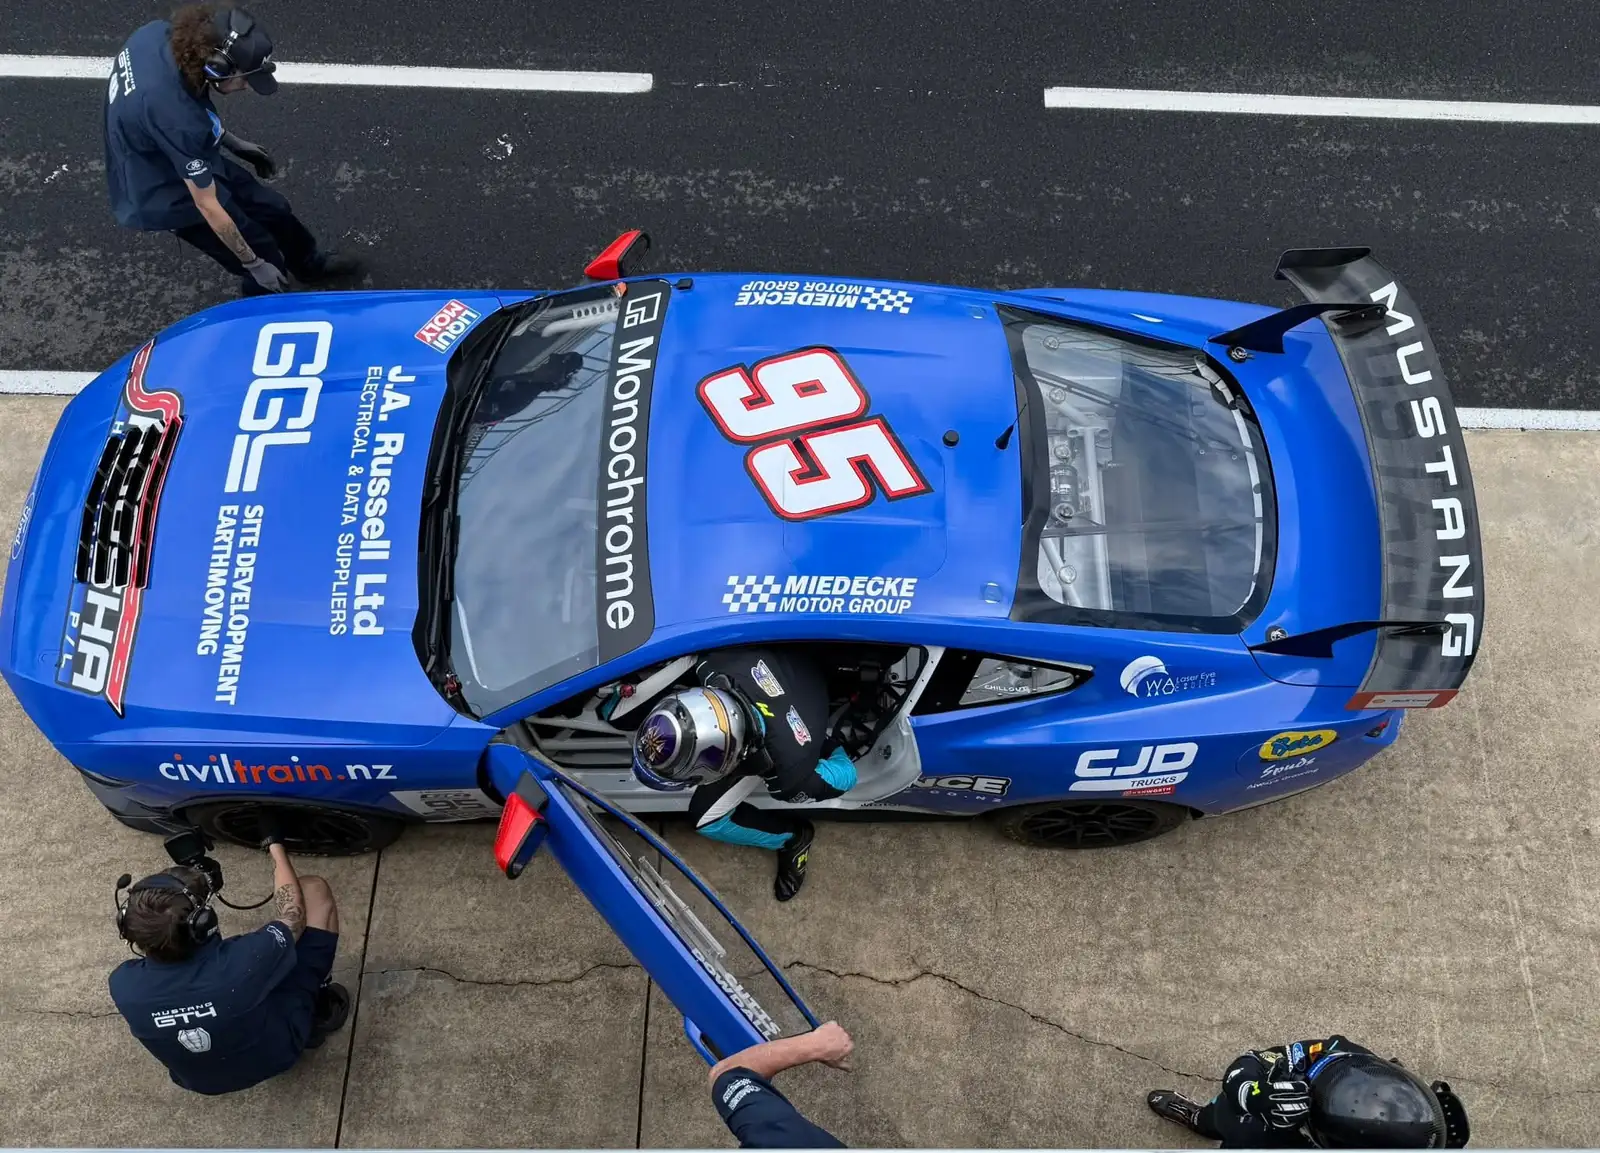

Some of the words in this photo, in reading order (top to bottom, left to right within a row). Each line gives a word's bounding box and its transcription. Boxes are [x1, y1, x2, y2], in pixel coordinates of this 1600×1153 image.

[734, 291, 858, 309] MIEDECKE
[741, 280, 800, 291] GROUP
[803, 281, 863, 295] MOTOR
[420, 300, 464, 343] MOLY
[432, 309, 478, 351] LIQUI
[350, 366, 382, 459] ELECTRICAL
[378, 365, 416, 422] J.A.
[697, 346, 932, 521] 95
[347, 465, 364, 476] &
[605, 335, 654, 630] Monochrome
[1369, 281, 1475, 657] MUSTANG
[341, 483, 362, 526] DATA
[359, 432, 405, 560] Russell
[239, 505, 264, 548] SITE
[197, 505, 239, 656] EARTHMOVING
[329, 532, 355, 635] SUPPLIERS
[784, 576, 917, 597] MIEDECKE
[352, 573, 388, 635] Ltd
[779, 598, 846, 612] MOTOR
[849, 598, 912, 614] GROUP
[215, 552, 257, 705] DEVELOPMENT
[1176, 674, 1199, 683] Laser
[1201, 672, 1216, 681] Eye
[158, 753, 398, 784] civiltrain.nz
[1074, 742, 1199, 778] CJD
[1130, 776, 1177, 787] TRUCKS
[151, 1001, 213, 1017] MUSTANG
[154, 1006, 217, 1028] GT4
